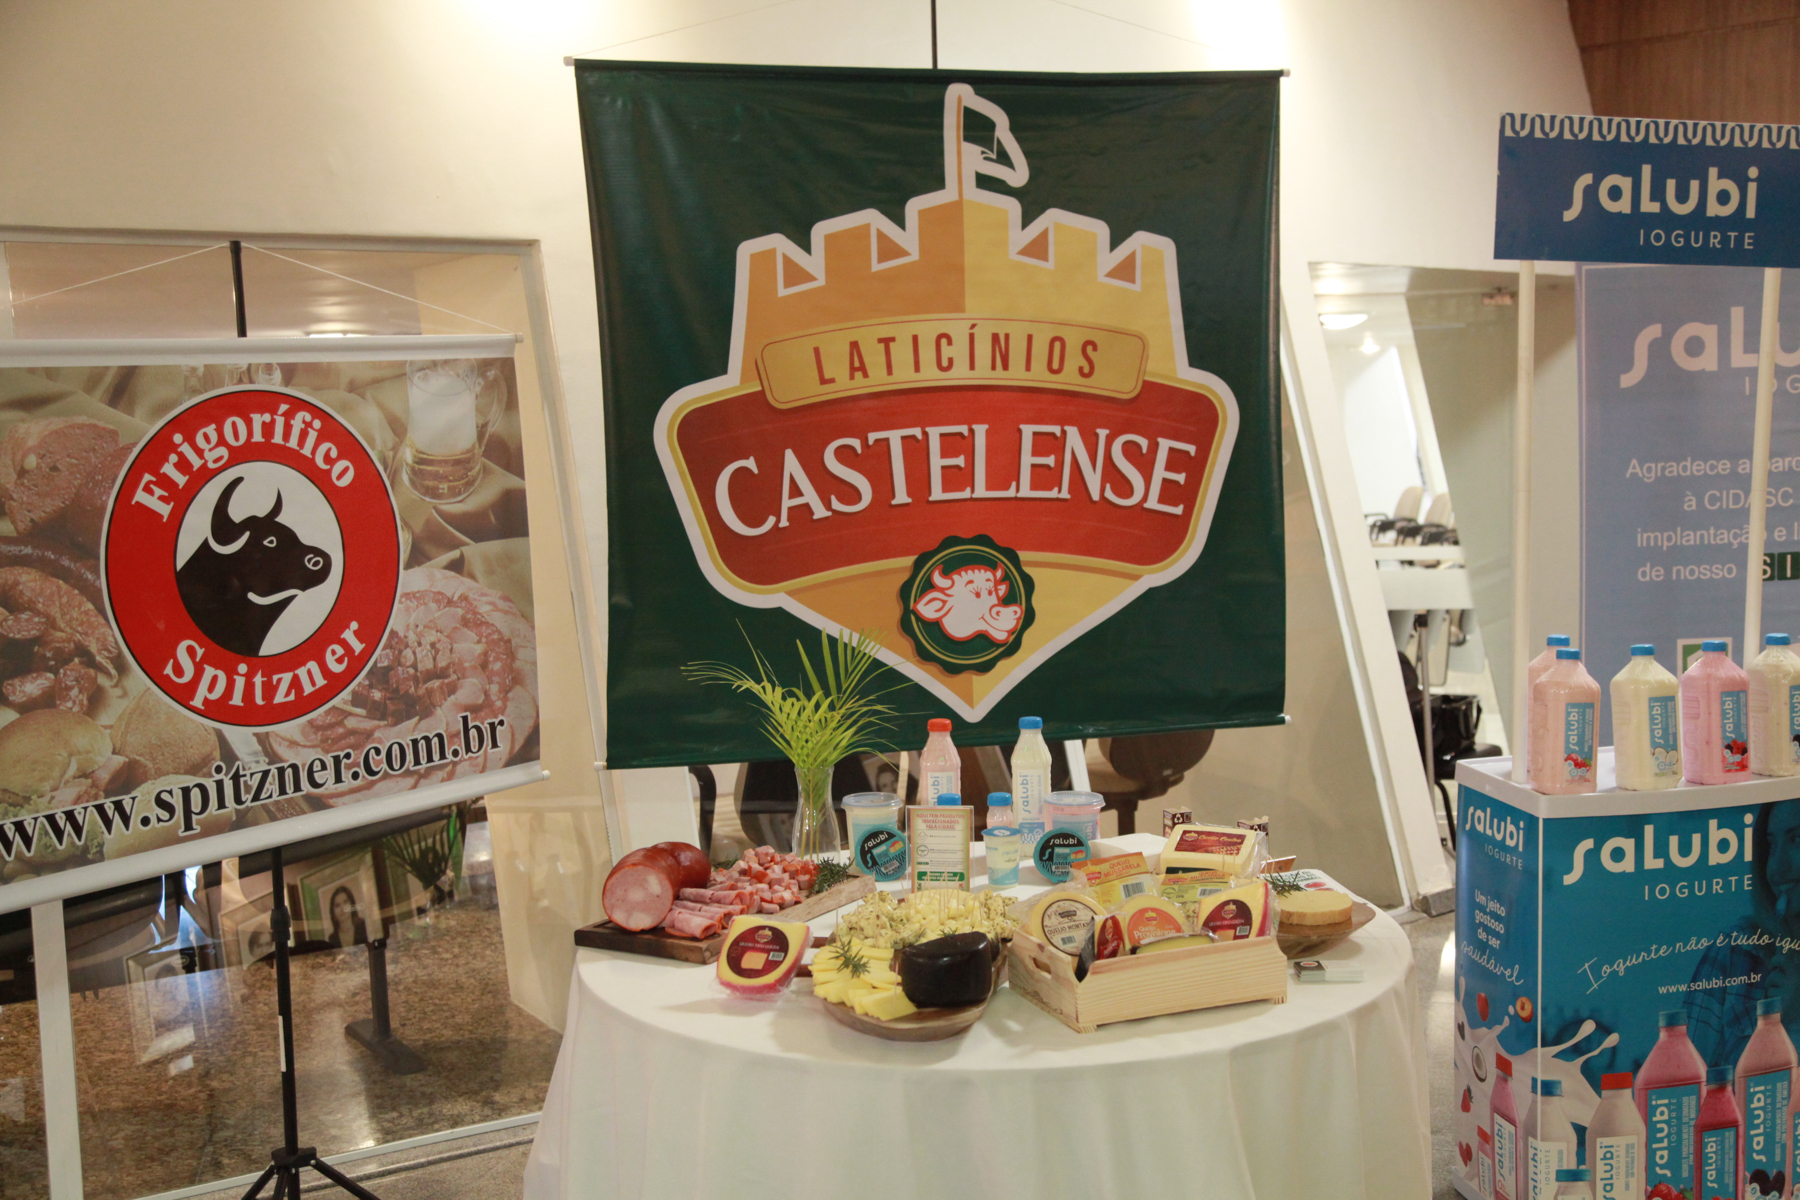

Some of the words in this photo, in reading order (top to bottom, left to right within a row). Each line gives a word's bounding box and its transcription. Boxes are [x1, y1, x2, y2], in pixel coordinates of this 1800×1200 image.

[1640, 229, 1755, 249] IOGURTE
[812, 323, 1100, 386] LATICÍNIOS
[131, 403, 356, 522] Frigorífico
[1626, 457, 1731, 483] Agradece
[715, 424, 1197, 536] CASTELENSE
[1684, 491, 1697, 511] à
[1637, 525, 1767, 551] implantaçã
[1774, 526, 1787, 541] e
[1638, 563, 1665, 582] de
[1672, 563, 1737, 581] nosso
[164, 619, 366, 709] Spitzner
[0, 714, 506, 860] www.spitzner.com.br
[1109, 859, 1130, 869] QUEIJO
[1484, 843, 1523, 870] IOGURTE
[1103, 863, 1141, 878] MUSSARELA
[1645, 874, 1753, 901] IOGURTE
[1475, 888, 1487, 905] Um
[1486, 898, 1506, 917] jeito
[1046, 926, 1067, 935] QUEIJO
[1475, 910, 1505, 934] gostoso
[1477, 926, 1487, 941] de
[1488, 935, 1501, 950] ser
[1461, 939, 1524, 986] saudável
[1577, 943, 1674, 995] Iogurte
[1674, 936, 1715, 954] não
[1716, 933, 1731, 947] é
[1730, 929, 1774, 947] tudo
[1658, 972, 1762, 995] www.salubi.com.br
